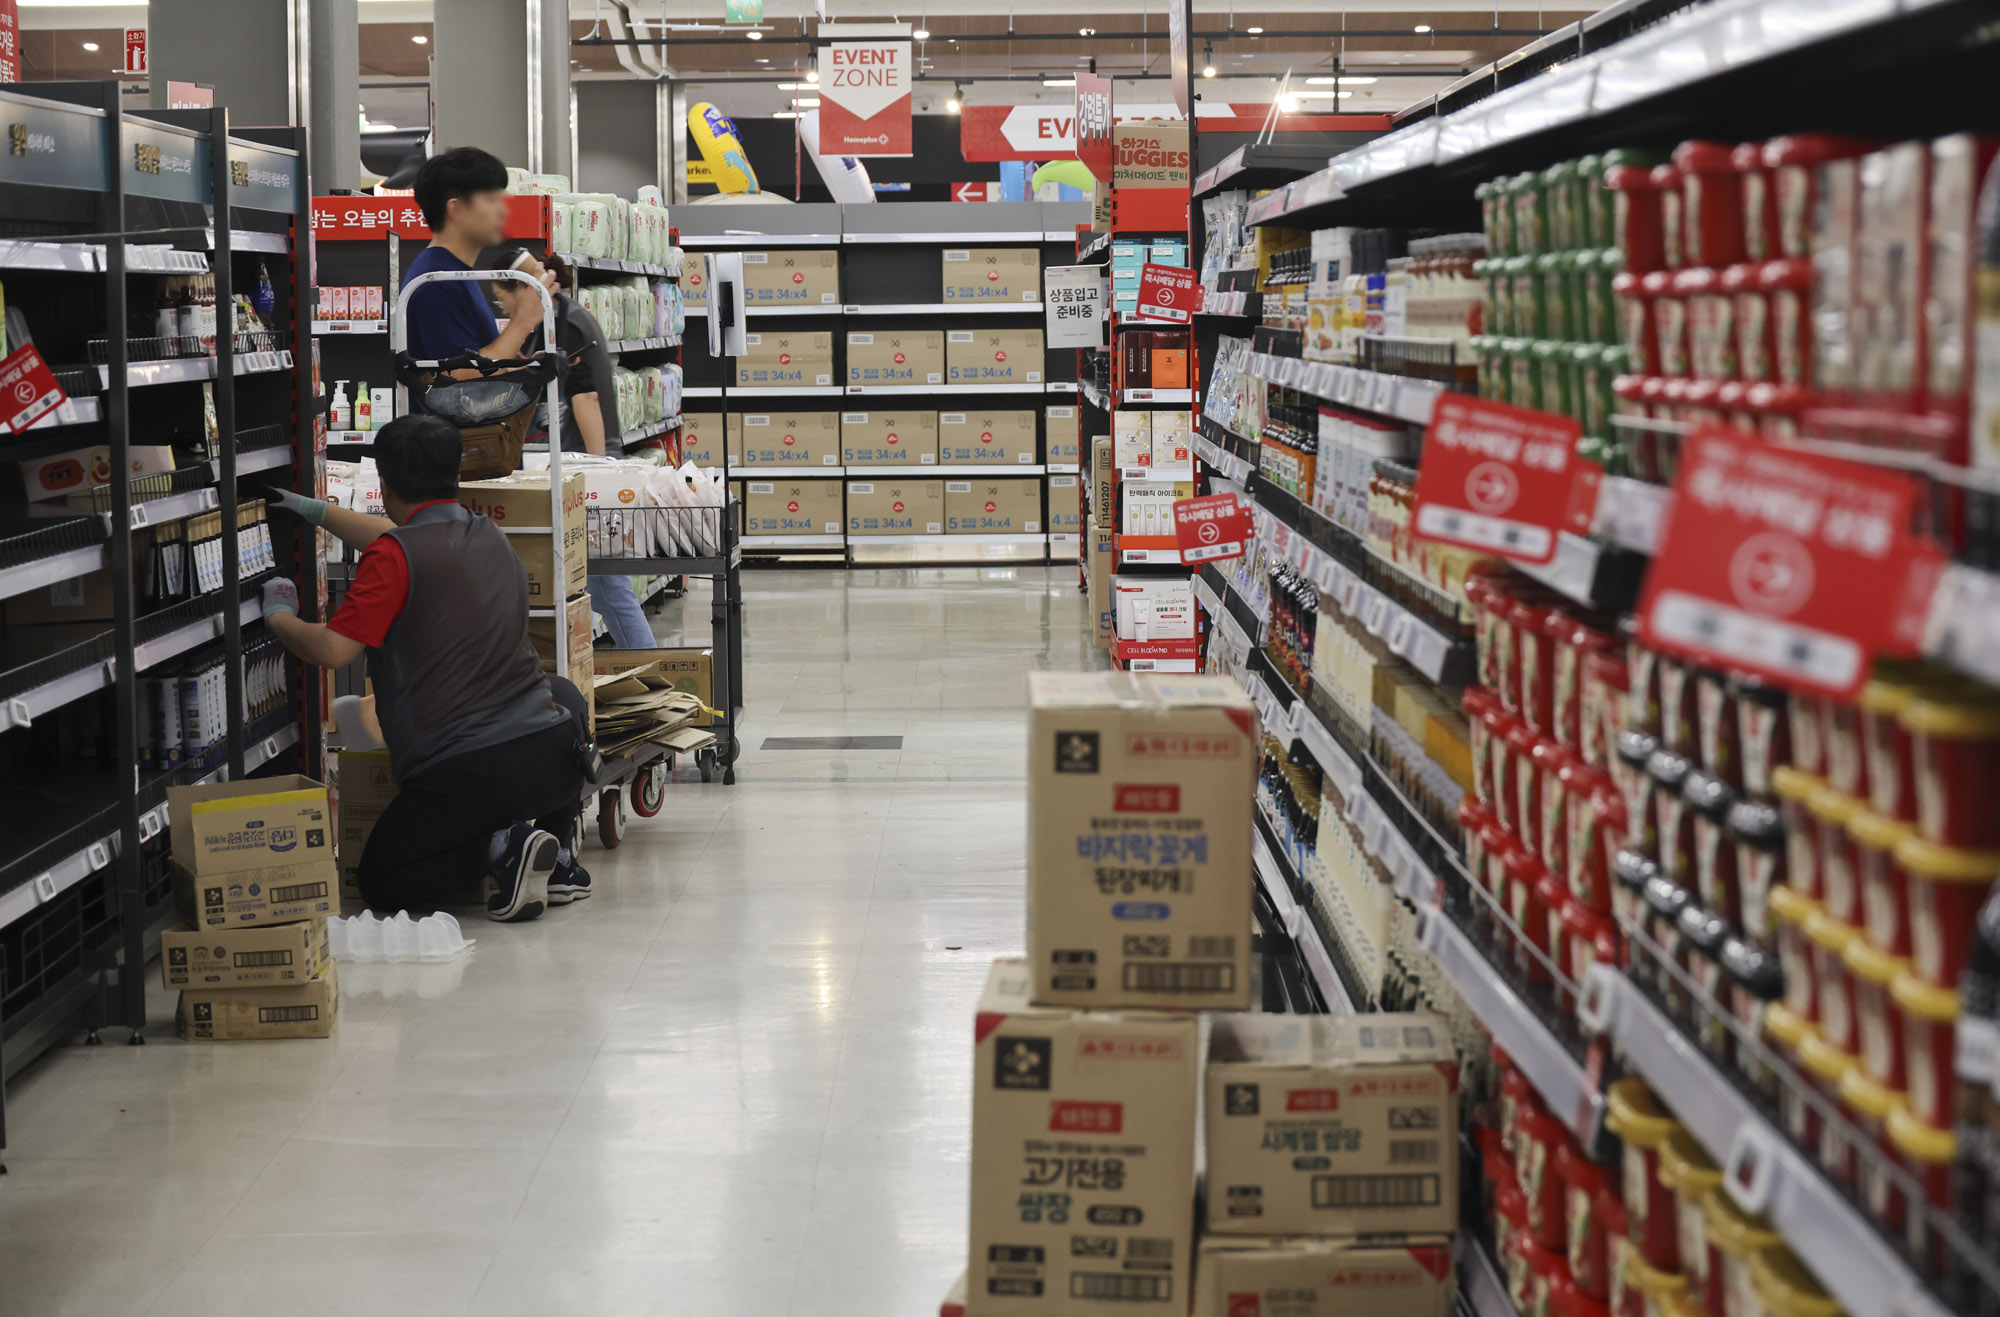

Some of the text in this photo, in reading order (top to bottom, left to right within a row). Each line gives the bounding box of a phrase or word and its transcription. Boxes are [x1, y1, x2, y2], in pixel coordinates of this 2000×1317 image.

[127, 32, 145, 41] 소화기
[833, 49, 898, 65] EVENT
[833, 69, 898, 87] ZONE
[1079, 91, 1110, 139] 강력특가
[1038, 118, 1075, 139] EV
[844, 136, 877, 145] Homeplus
[1121, 137, 1161, 149] 하기스
[1114, 169, 1188, 181] 이처메이드 팬티
[343, 209, 394, 229] 오늘의
[1145, 273, 1175, 286] 즉시배달
[1176, 278, 1192, 289] 상품
[745, 288, 755, 300] 5
[946, 286, 955, 298] 5
[1050, 287, 1099, 303] 상품입고
[1056, 304, 1093, 319] 준비중
[740, 370, 749, 382] 5
[851, 368, 860, 379] 5
[950, 367, 959, 378] 5
[747, 450, 756, 462] 5
[845, 449, 853, 461] 5
[942, 447, 951, 460] 5
[1051, 444, 1059, 456] 4
[1129, 489, 1184, 497] 탄력매직 아이크림
[1052, 514, 1061, 526] 4
[1178, 508, 1214, 523] 즉시배달
[1216, 505, 1235, 518] 상품
[750, 518, 758, 530] 5
[851, 517, 859, 529] 5
[949, 517, 957, 529] 5
[1140, 646, 1158, 654] BLOOM
[1076, 833, 1208, 865] 바지락꽃게
[1020, 1156, 1126, 1191] 고기전용
[1017, 1192, 1072, 1225] 쌈장
